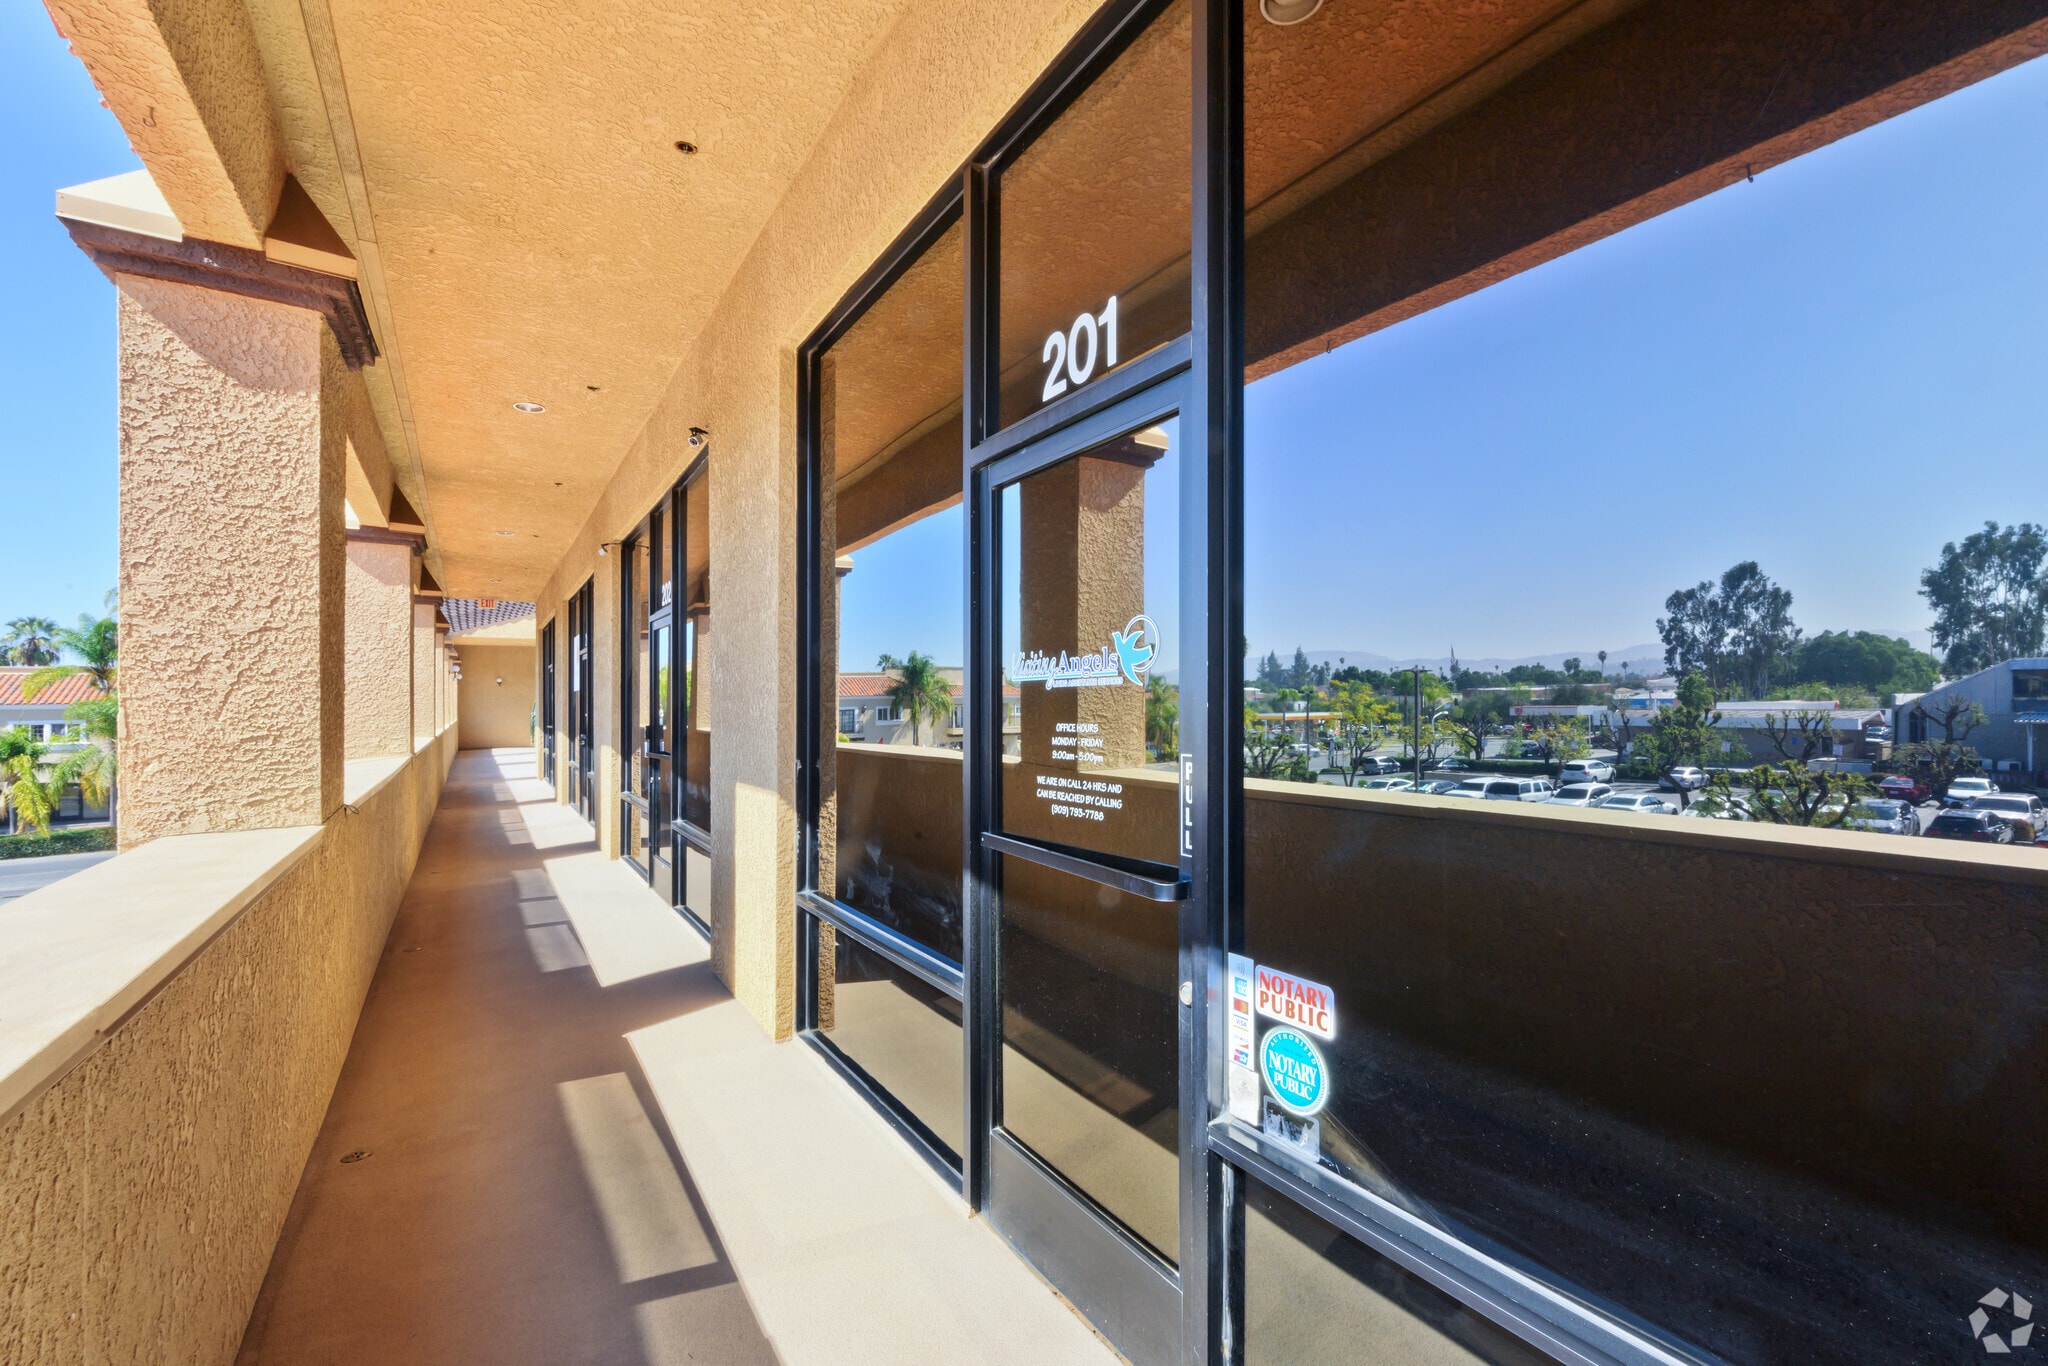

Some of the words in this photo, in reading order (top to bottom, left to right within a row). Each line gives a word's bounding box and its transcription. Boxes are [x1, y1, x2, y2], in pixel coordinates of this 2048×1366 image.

[1043, 295, 1117, 402] 201
[481, 599, 495, 608] EXIT
[1012, 650, 1057, 690] Visiting
[1057, 646, 1119, 675] Angels
[1056, 723, 1076, 732] OFFICE
[1077, 723, 1099, 733] HOURS
[1052, 737, 1077, 746] MONDAY
[1081, 738, 1104, 748] FRIDAY
[1052, 750, 1075, 760] 9:00am
[1037, 776, 1046, 785] WE
[1046, 777, 1057, 786] ARE
[1058, 778, 1067, 787] ON
[1067, 779, 1081, 789] CALL
[1083, 781, 1092, 790] 24
[1093, 783, 1106, 792] HRS
[1108, 784, 1122, 794] AND
[1037, 789, 1048, 798] CAN
[1049, 791, 1057, 800] BE
[1057, 792, 1085, 803] REACHED
[1085, 795, 1094, 805] BY
[1095, 797, 1122, 809] CALLING
[1052, 804, 1069, 817] (909)
[1260, 970, 1328, 1010] NOTARY
[1260, 990, 1328, 1032] PUBLIC
[1270, 1033, 1318, 1065] AUTHORIZED
[1268, 1049, 1318, 1087] NOTARY
[1274, 1071, 1313, 1101] PUBLIC
